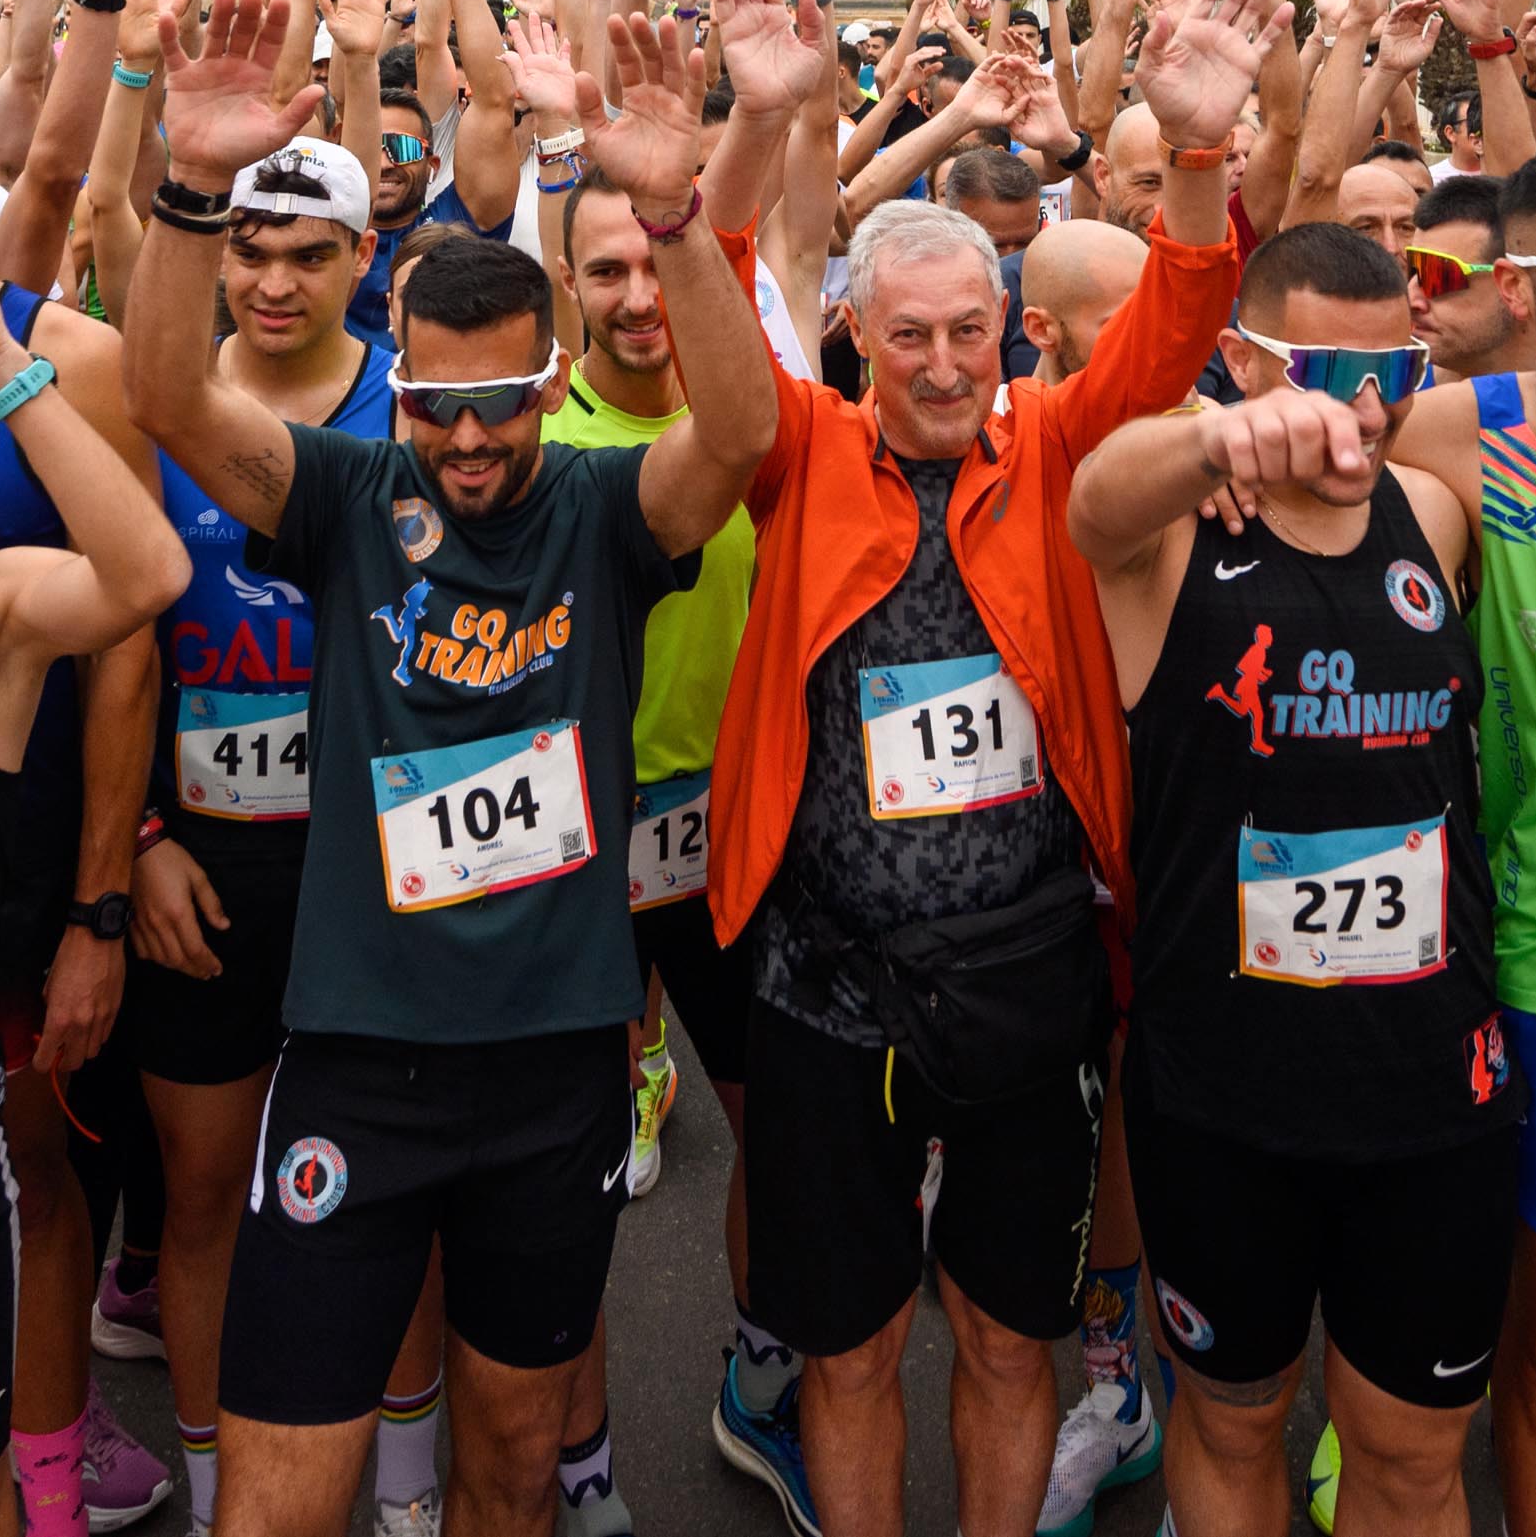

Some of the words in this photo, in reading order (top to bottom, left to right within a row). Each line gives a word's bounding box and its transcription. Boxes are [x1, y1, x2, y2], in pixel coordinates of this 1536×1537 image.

[415, 605, 572, 689] TRAINING
[452, 604, 508, 651] GQ
[1299, 649, 1356, 696] GQ
[912, 699, 1004, 761] 131
[1271, 688, 1453, 738] TRAINING
[213, 732, 308, 777] 414
[428, 775, 540, 850] 104
[1293, 875, 1406, 934] 273
